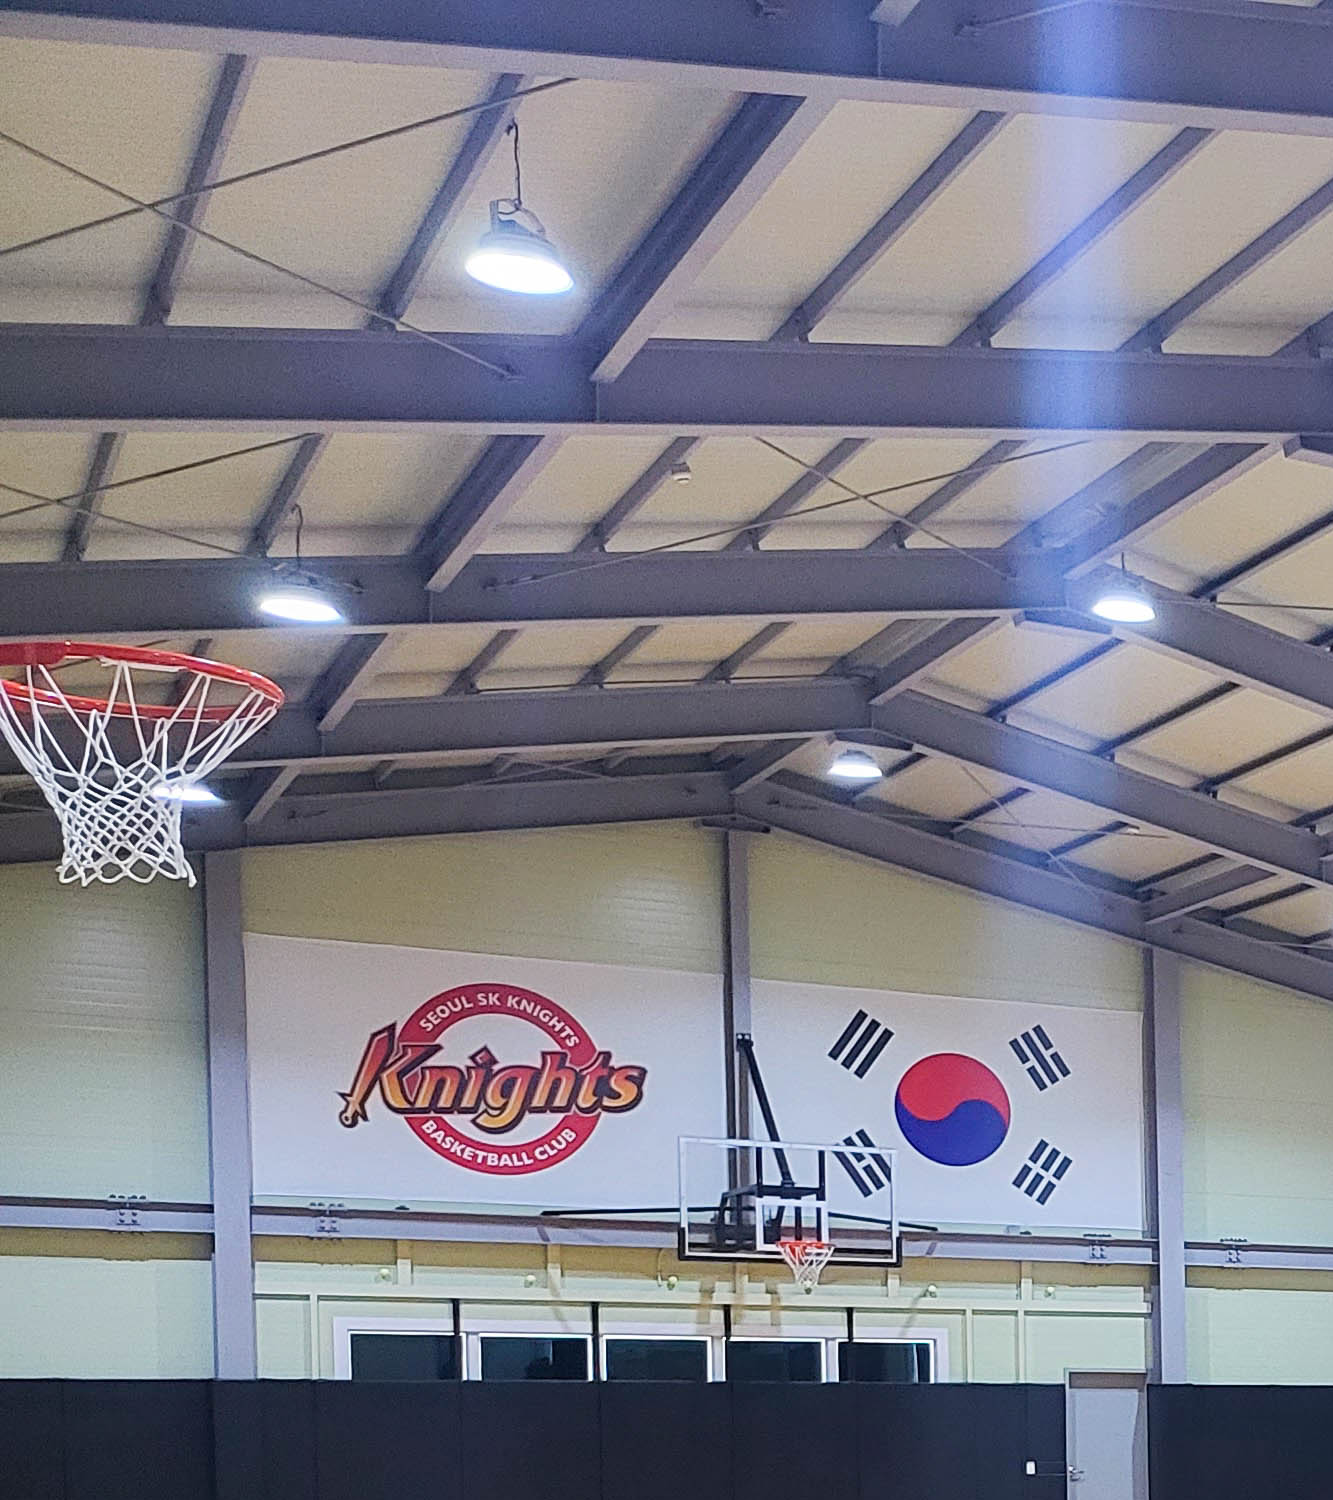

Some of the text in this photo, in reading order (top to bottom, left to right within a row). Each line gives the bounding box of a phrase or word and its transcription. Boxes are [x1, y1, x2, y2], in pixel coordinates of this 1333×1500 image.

[418, 992, 580, 1048] SEOUL SK KNIGHTS
[335, 1021, 648, 1134] Knights
[421, 1120, 577, 1167] BASKETBALL CLUB
